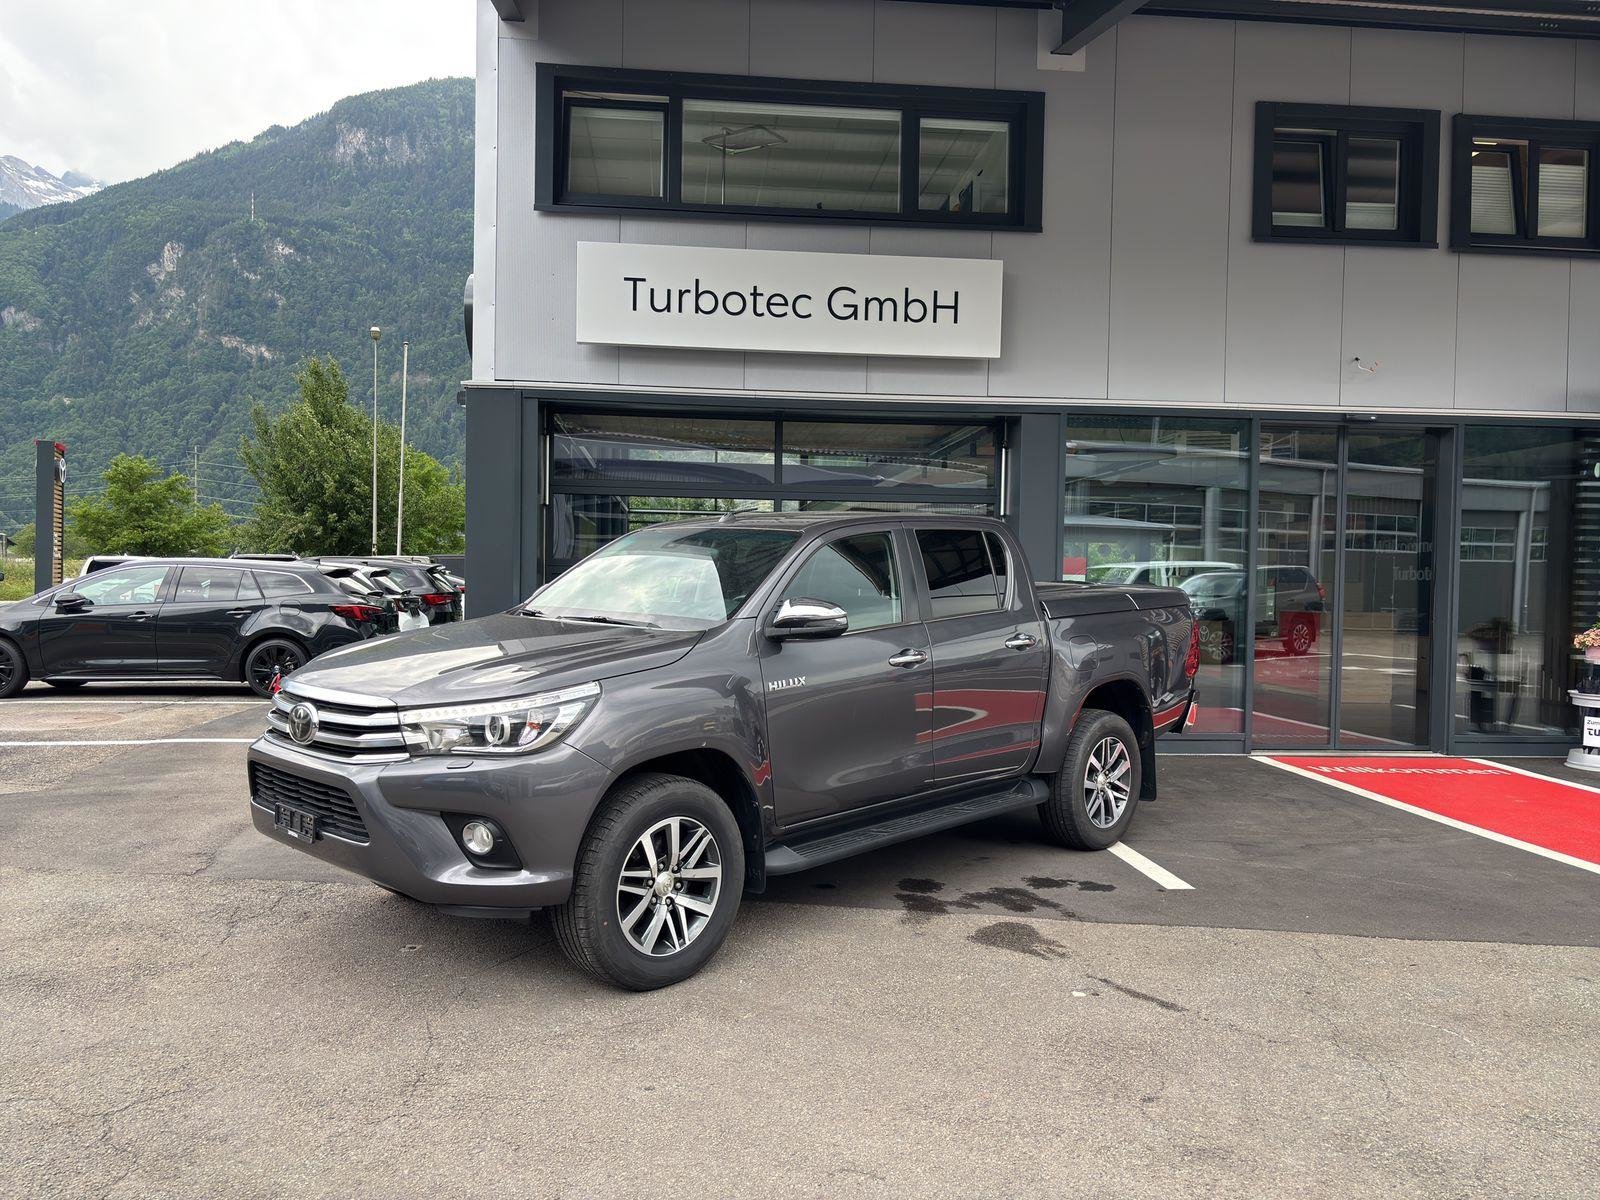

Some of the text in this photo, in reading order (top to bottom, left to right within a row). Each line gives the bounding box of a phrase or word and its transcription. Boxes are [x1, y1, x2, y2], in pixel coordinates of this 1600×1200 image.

[623, 276, 960, 325] Turbotec GmbH
[768, 675, 806, 691] HILUX
